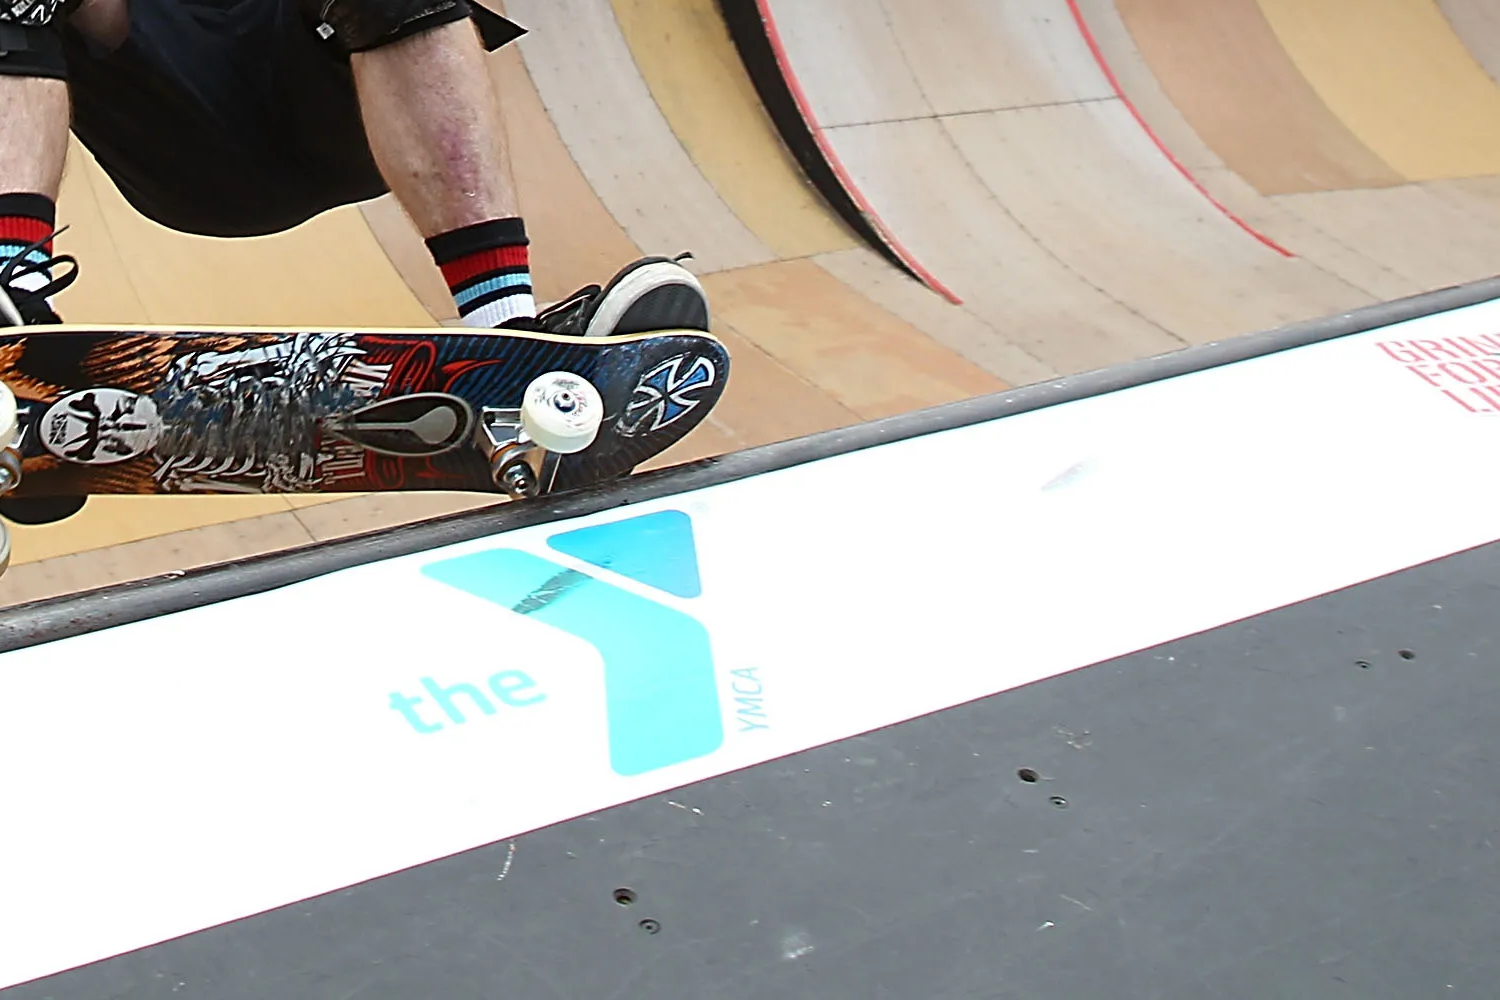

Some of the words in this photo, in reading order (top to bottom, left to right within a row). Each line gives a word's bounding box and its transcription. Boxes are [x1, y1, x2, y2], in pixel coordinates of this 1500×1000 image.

[1375, 333, 1500, 363] GRIN
[388, 669, 547, 734] the
[730, 667, 770, 732] YMCA
